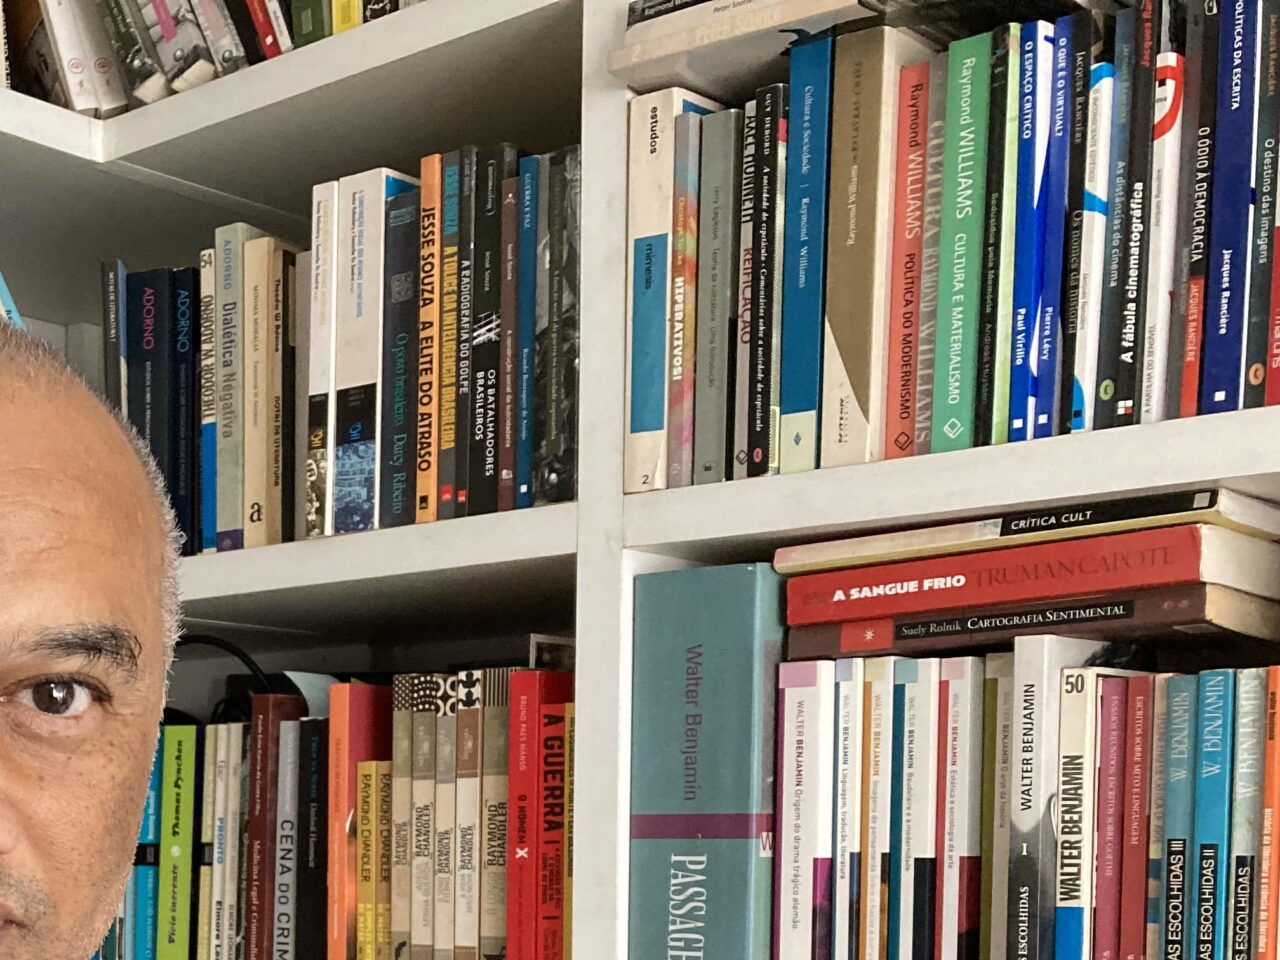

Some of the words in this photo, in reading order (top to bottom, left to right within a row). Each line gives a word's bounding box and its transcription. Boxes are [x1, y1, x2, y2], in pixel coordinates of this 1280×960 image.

[1024, 41, 1034, 50] O
[958, 57, 976, 125] Raymond
[1023, 53, 1034, 93] ESPAÇO
[649, 106, 658, 154] estudos
[906, 83, 923, 148] Raymond
[1023, 95, 1034, 139] CRÍTICO
[1198, 127, 1210, 136] O
[1196, 139, 1210, 169] ÓDIO
[1264, 138, 1275, 148] O
[956, 127, 976, 219] WILLIAMS
[1262, 150, 1275, 188] destino
[904, 150, 925, 239] WILLIAMS
[1261, 191, 1272, 213] das
[421, 207, 435, 252] JESSE
[1125, 182, 1145, 298] cinematográfica
[1191, 181, 1208, 263] DEMOCRACIA
[1258, 215, 1272, 264] imagens
[223, 239, 233, 291] ADORNO
[420, 253, 434, 308] SOUZA
[644, 243, 653, 290] mimesis
[903, 252, 918, 308] POLÍTICA
[952, 233, 967, 291] CULTURA
[1222, 249, 1233, 289] Jacques
[143, 287, 155, 350] ADORNO
[177, 290, 190, 353] ADORNO
[222, 301, 237, 369] Dialética
[420, 321, 434, 332] A
[902, 311, 914, 329] DO
[1016, 308, 1027, 332] Paul
[1044, 307, 1054, 335] Pierre
[1121, 302, 1137, 347] fábula
[1219, 291, 1231, 335] Rancière
[419, 336, 433, 377] ELITE
[948, 307, 964, 405] MATERIALISMO
[1016, 333, 1026, 366] Virilio
[1041, 337, 1053, 361] Lévy
[1120, 351, 1134, 363] A
[419, 382, 432, 406] DO
[487, 369, 496, 384] OS
[899, 333, 913, 420] MODERNISMO
[222, 372, 237, 439] Negativa
[475, 371, 485, 441] BRASILEIROS
[418, 412, 432, 472] ATRASO
[486, 388, 496, 477] BATALHADORES
[1011, 515, 1057, 531] CRÍTICA
[1062, 510, 1093, 524] CULT
[833, 589, 846, 601] A
[850, 580, 919, 600] SANGUE
[923, 574, 966, 592] FRIO
[901, 624, 927, 638] Suely
[930, 620, 962, 633] Rolnik
[967, 611, 1044, 630] CARTOGRAFIA
[1046, 603, 1127, 623] SENTIMENTAL
[685, 643, 704, 706] Walter
[1065, 674, 1085, 694] 50
[543, 713, 565, 727] A
[796, 700, 805, 737] WALTER
[1022, 683, 1036, 753] BENJAMIN
[681, 713, 703, 802] Benjamin
[794, 739, 804, 787] BENJAMIN
[361, 774, 372, 823] RAYMOND
[543, 734, 565, 833] GUERRA
[793, 788, 803, 824] Origem
[1021, 757, 1033, 812] WALTER
[1061, 754, 1084, 837] BENJAMIN
[278, 819, 294, 876] CENA
[360, 825, 371, 883] CHANDLER
[415, 806, 423, 857] RAYMOND
[422, 804, 431, 858] CHANDLER
[487, 804, 498, 866] RAYMOND
[496, 801, 508, 866] CHANDLER
[793, 826, 802, 835] do
[793, 836, 801, 863] drama
[1021, 843, 1028, 856] I
[1171, 840, 1184, 850] III
[1203, 849, 1215, 857] II
[277, 882, 290, 905] DO
[1059, 839, 1082, 902] WALTER
[791, 898, 800, 930] alemão
[1017, 886, 1029, 954] ESCOLHIDAS
[1167, 854, 1184, 944] ESCOLHIDAS
[1199, 860, 1215, 942] ESCOLHIDAS
[1235, 867, 1251, 952] ESCOLHIDAS
